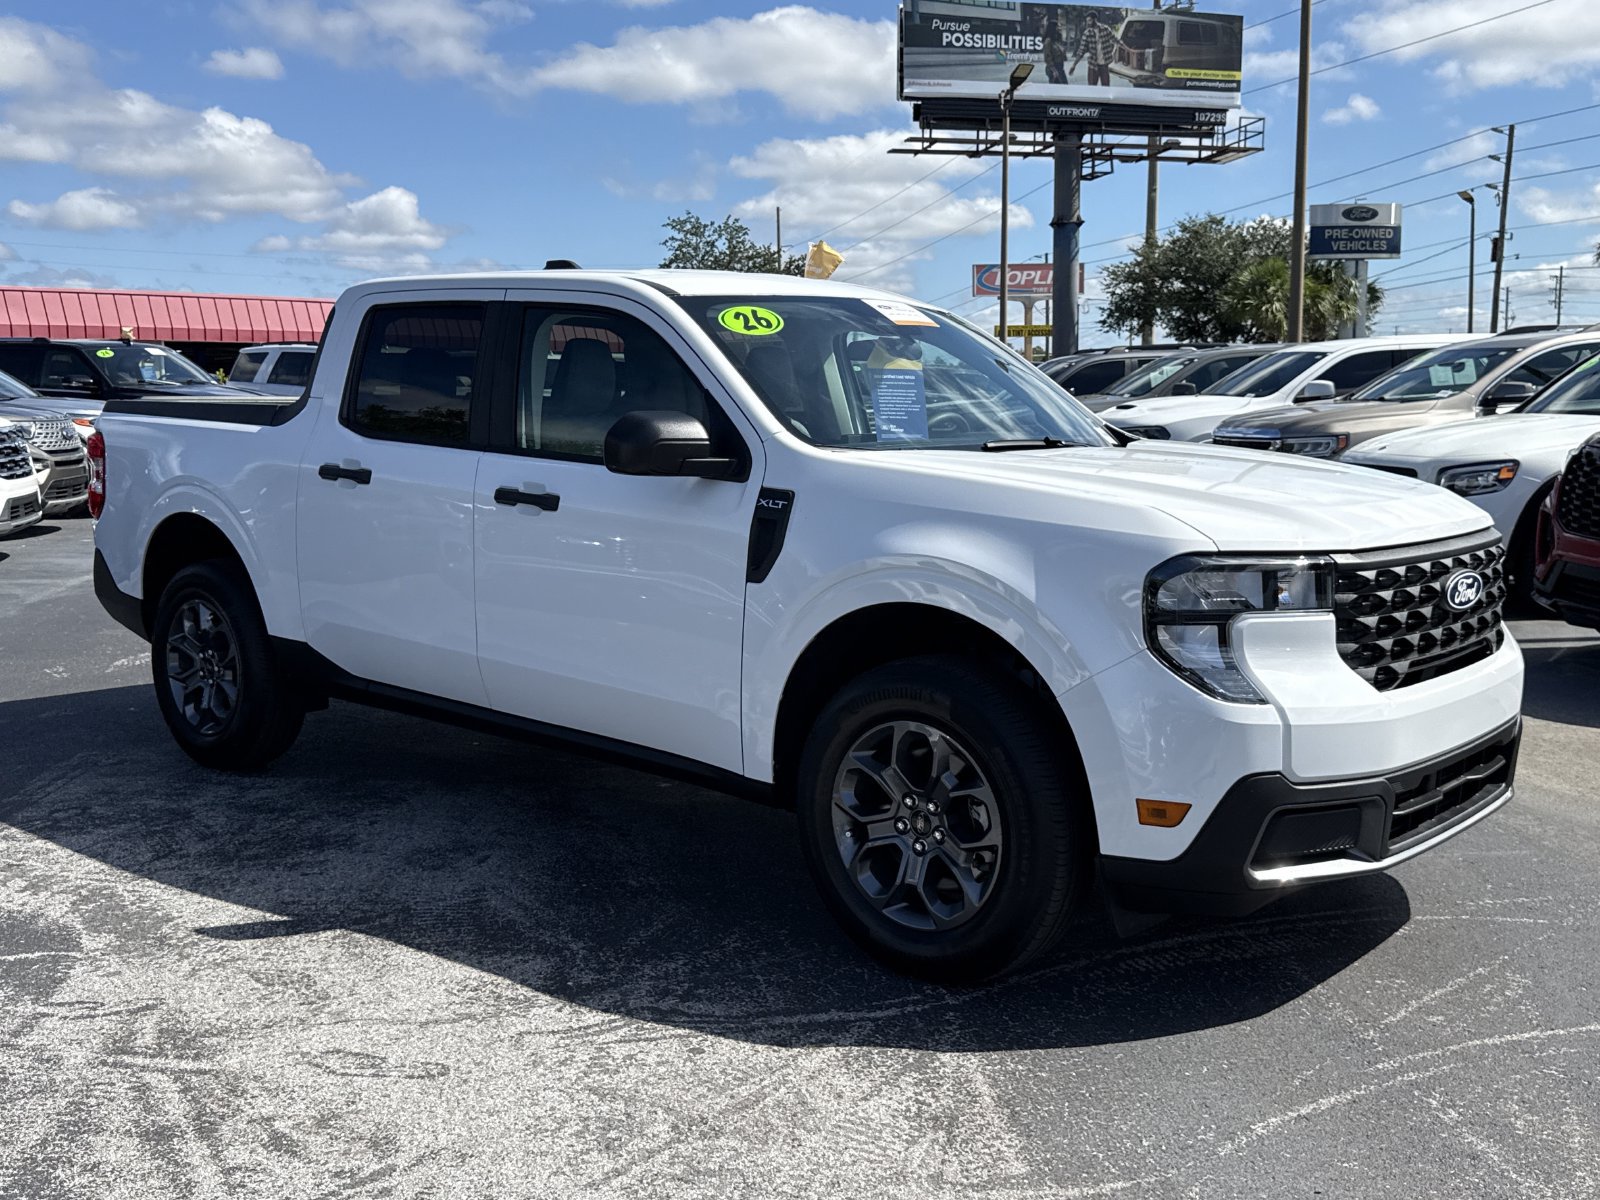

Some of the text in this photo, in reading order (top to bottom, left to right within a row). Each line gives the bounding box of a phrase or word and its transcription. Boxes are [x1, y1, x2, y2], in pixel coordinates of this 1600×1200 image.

[931, 19, 970, 31] Pursue
[942, 32, 1043, 50] POSSIBILITIES
[1350, 208, 1373, 219] Ford
[1324, 228, 1393, 239] PRE-OWNED
[1331, 240, 1387, 251] VEHICLES
[991, 268, 1054, 286] TOPLI
[734, 309, 773, 331] 26
[757, 498, 788, 509] XLT
[1454, 577, 1478, 604] Ford
